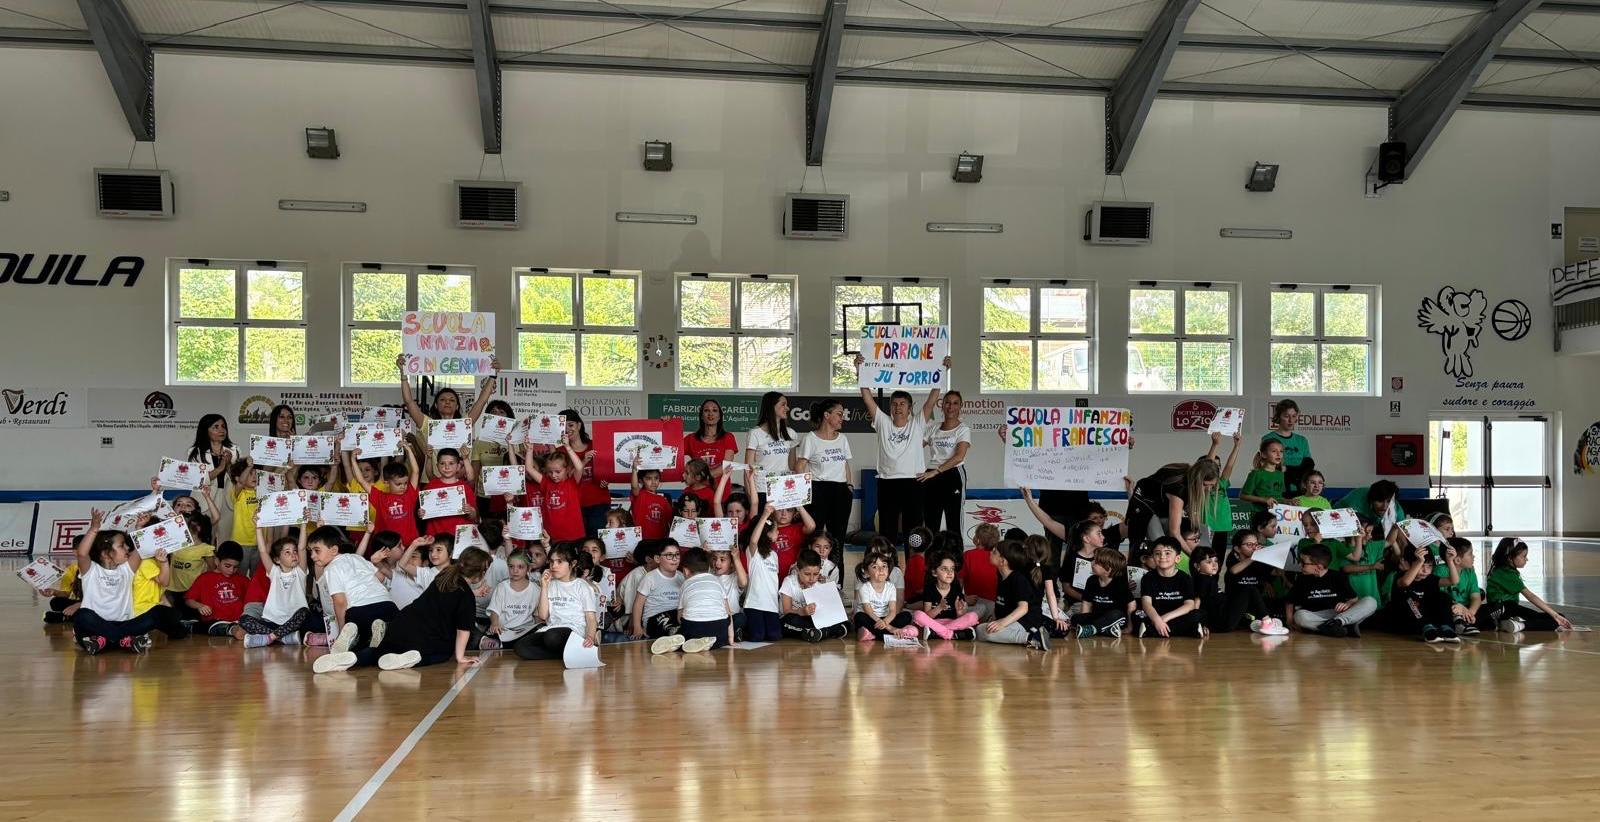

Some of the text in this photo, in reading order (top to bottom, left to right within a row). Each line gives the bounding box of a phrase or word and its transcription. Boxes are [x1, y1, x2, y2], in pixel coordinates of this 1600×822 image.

[1552, 258, 1600, 283] DEFE
[404, 312, 486, 335] SCUOLA
[862, 325, 947, 339] SCUOLA INFANZIA
[874, 342, 934, 360] TORRIONE
[514, 378, 538, 388] MIM
[874, 370, 893, 383] JU
[1456, 377, 1525, 391] Senza paura
[2, 389, 69, 415] Verdi
[1443, 396, 1478, 406] sudore
[1492, 399, 1535, 410] coraggio
[14, 418, 51, 426] Restaurant
[1007, 408, 1130, 425] SCUOLA INFANZIA
[1298, 415, 1351, 426] EDILFRAIR
[1012, 427, 1128, 448] SAN FRANCESCO
[1275, 508, 1303, 521] SCUO
[1276, 525, 1300, 536] ARLA
[1, 538, 25, 547] ele
